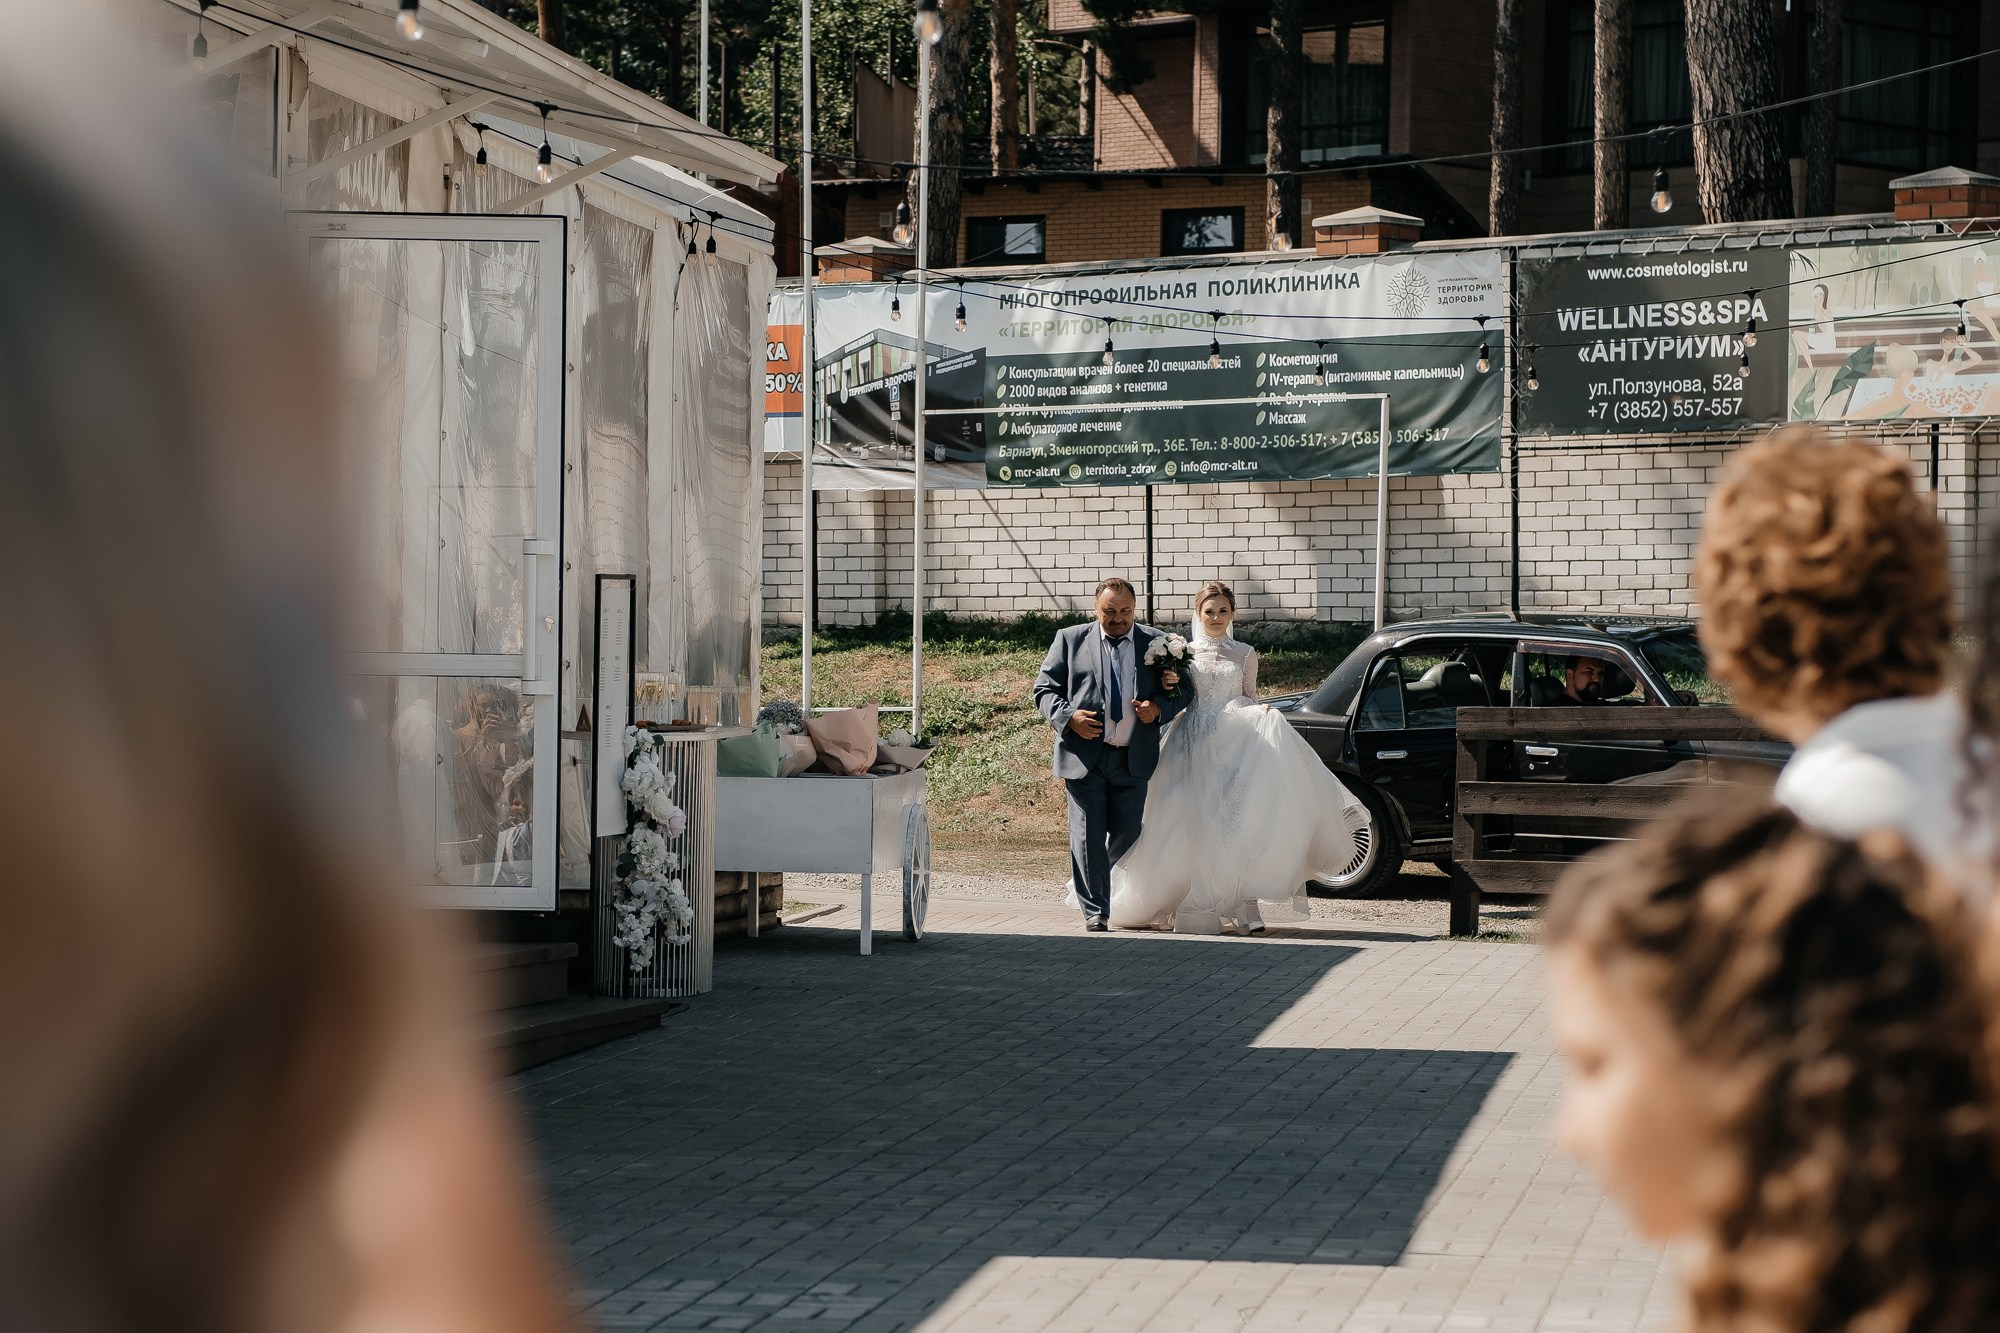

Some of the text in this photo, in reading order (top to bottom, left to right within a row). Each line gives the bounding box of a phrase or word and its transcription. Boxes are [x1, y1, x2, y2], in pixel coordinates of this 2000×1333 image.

[1587, 259, 1748, 280] www.cosmetologist.ru
[999, 273, 1361, 310] МНОГОПРОФИЛЬНАЯ ПОЛИКЛИНИКА
[1437, 283, 1493, 294] ТЕРРИТОРИЯ
[1437, 294, 1485, 306] ЗДОРОВЬЯ
[1557, 298, 1768, 331] WELLNESS&SPA
[1269, 353, 1338, 367] Косметология
[1577, 335, 1745, 363] «АНТУРИУМ»
[1009, 355, 1241, 381] Консультации врачей более 20 специальнстей
[1269, 364, 1465, 388] IV-терап (витаминные капельницы)
[1009, 385, 1035, 398] 2000
[1037, 385, 1067, 398] видов
[1069, 382, 1113, 396] анализов
[1124, 380, 1168, 393] генетика
[1588, 373, 1743, 399] ул.Ползунова, 52а
[1269, 411, 1307, 425] Массаж
[1588, 397, 1743, 422] +7 (3852) 557-557
[1011, 420, 1122, 436] Амбулаторное лечение
[999, 445, 1047, 458] Барнаул,
[1049, 440, 1139, 455] Змеиногорский
[1141, 441, 1161, 455] тр.,
[1190, 438, 1217, 451] Тел.:
[1220, 433, 1327, 449] 8-800-2-506-517;
[1341, 432, 1348, 446] 7
[1351, 431, 1392, 448] (385)
[1396, 428, 1450, 443] 506-517
[1015, 460, 1258, 478] mcr-alt.ru territoria_zdrav info@mcr-alt.ru
